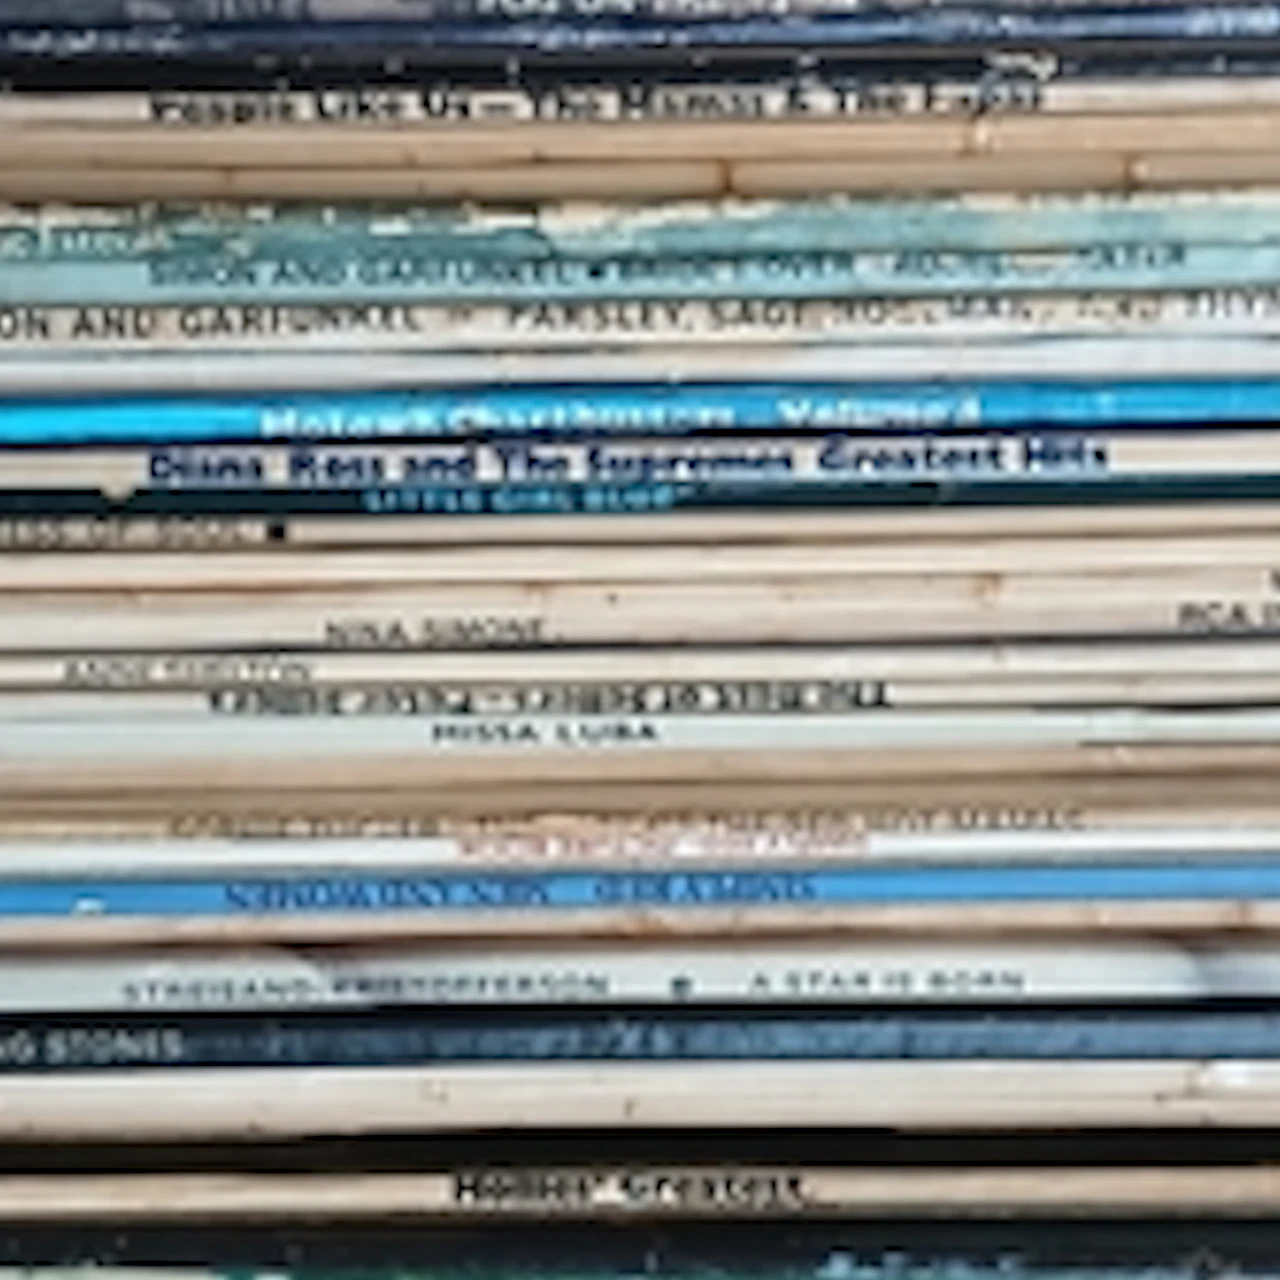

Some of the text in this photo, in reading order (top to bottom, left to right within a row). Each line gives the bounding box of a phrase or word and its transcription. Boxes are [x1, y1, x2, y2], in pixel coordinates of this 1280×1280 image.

[71, 308, 152, 339] AND
[497, 449, 570, 480] The
[787, 970, 869, 993] STAR
[930, 969, 1024, 993] BORN
